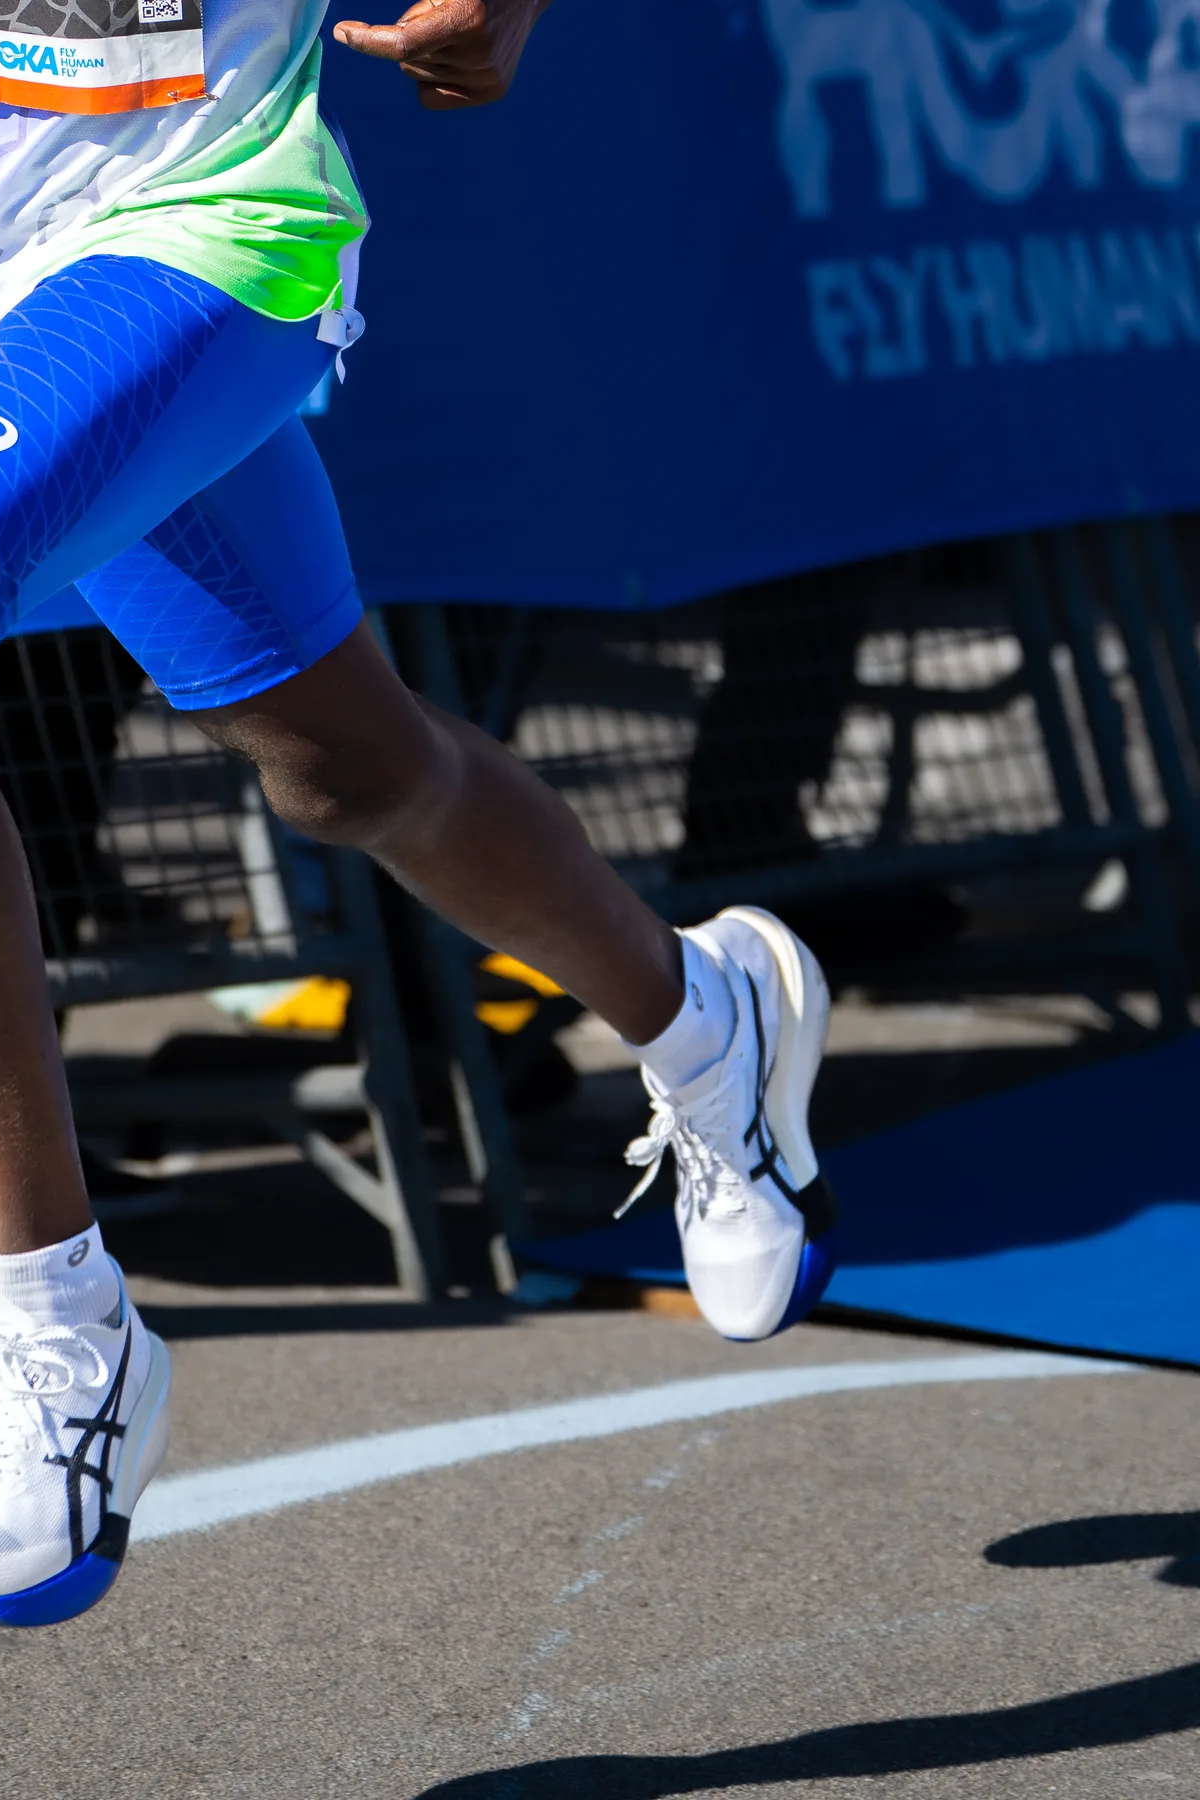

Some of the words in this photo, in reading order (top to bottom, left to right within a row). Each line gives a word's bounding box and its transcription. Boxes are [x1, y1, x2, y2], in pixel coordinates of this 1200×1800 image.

[60, 47, 77, 58] FLY
[61, 57, 105, 68] HUMAN
[61, 67, 79, 78] FLY
